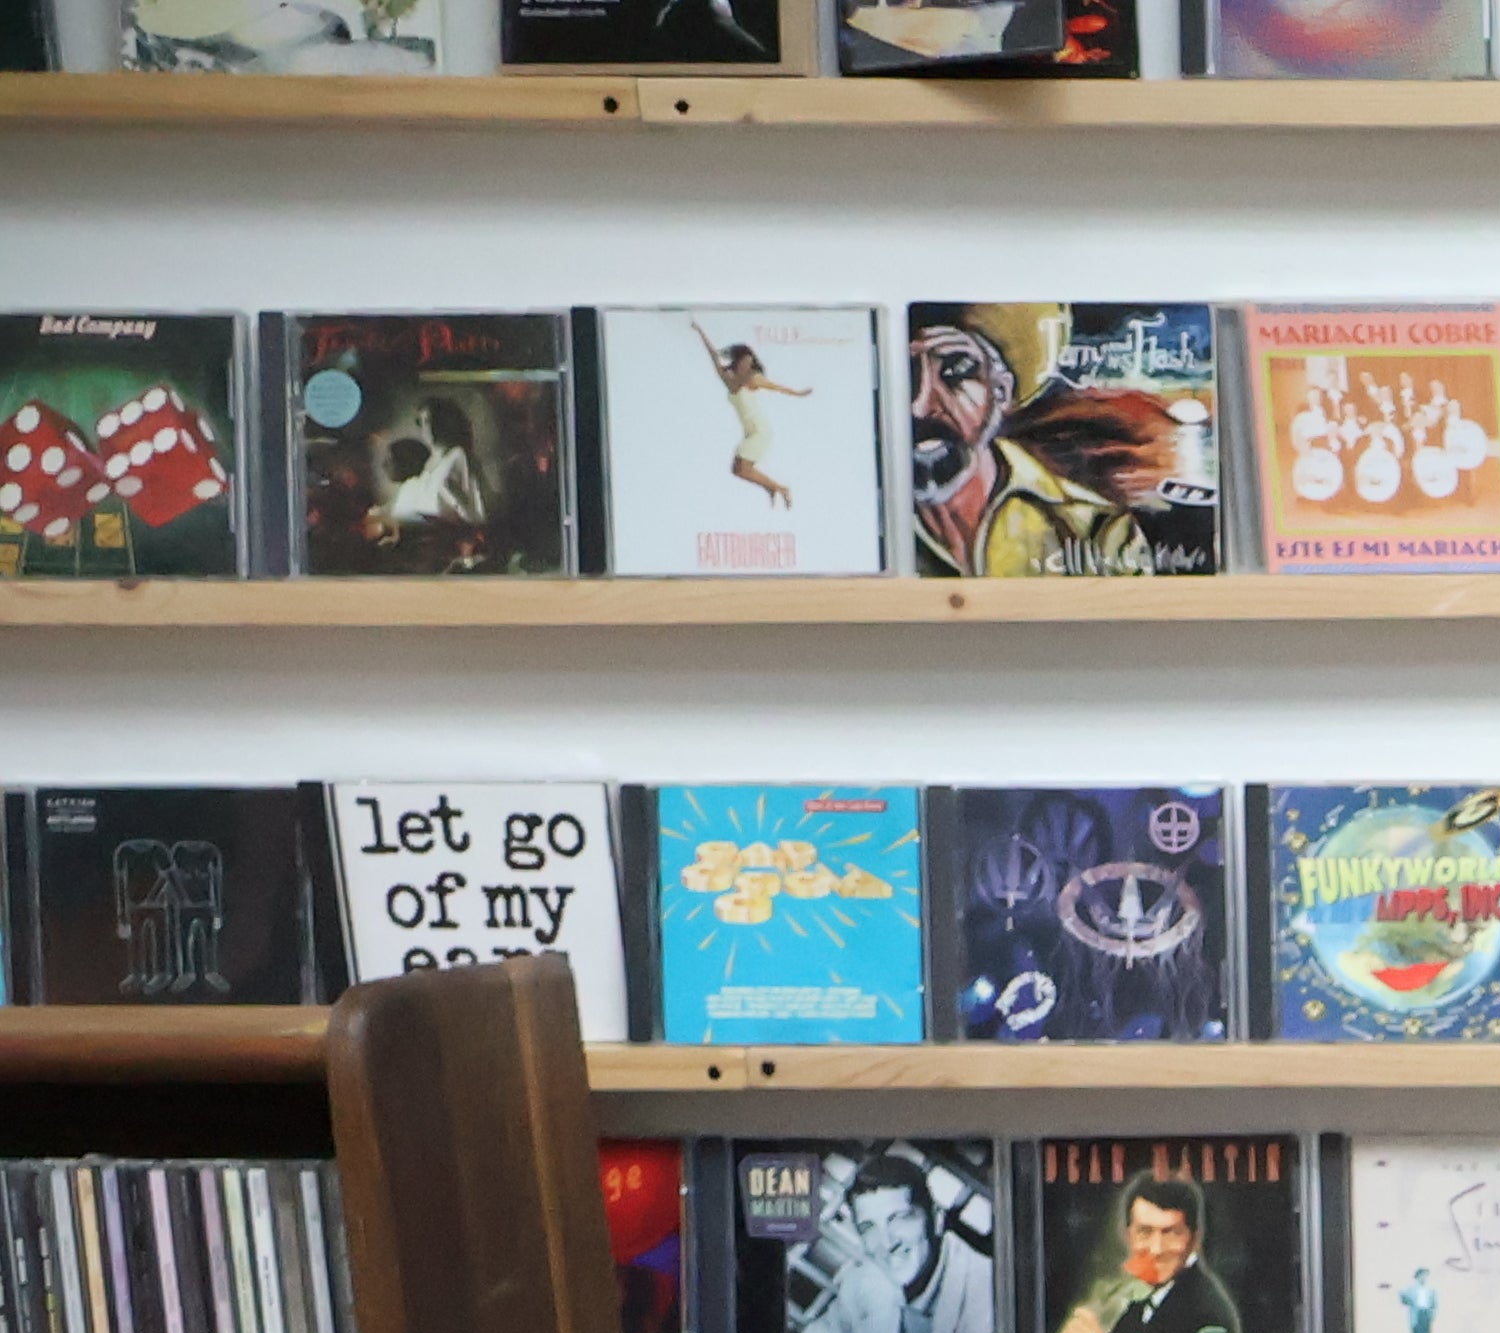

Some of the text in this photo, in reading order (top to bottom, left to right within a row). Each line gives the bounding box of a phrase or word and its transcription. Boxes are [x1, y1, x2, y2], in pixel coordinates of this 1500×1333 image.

[76, 315, 158, 340] Company
[1258, 322, 1500, 346] MARIACHI COBRE
[1275, 540, 1324, 559] ESTE
[1332, 540, 1356, 558] ES
[1362, 539, 1391, 557] MI
[355, 794, 586, 870] let go
[386, 870, 575, 944] of my
[1044, 1142, 1281, 1184] DEAN MARTIN
[748, 1165, 811, 1199] DEAN
